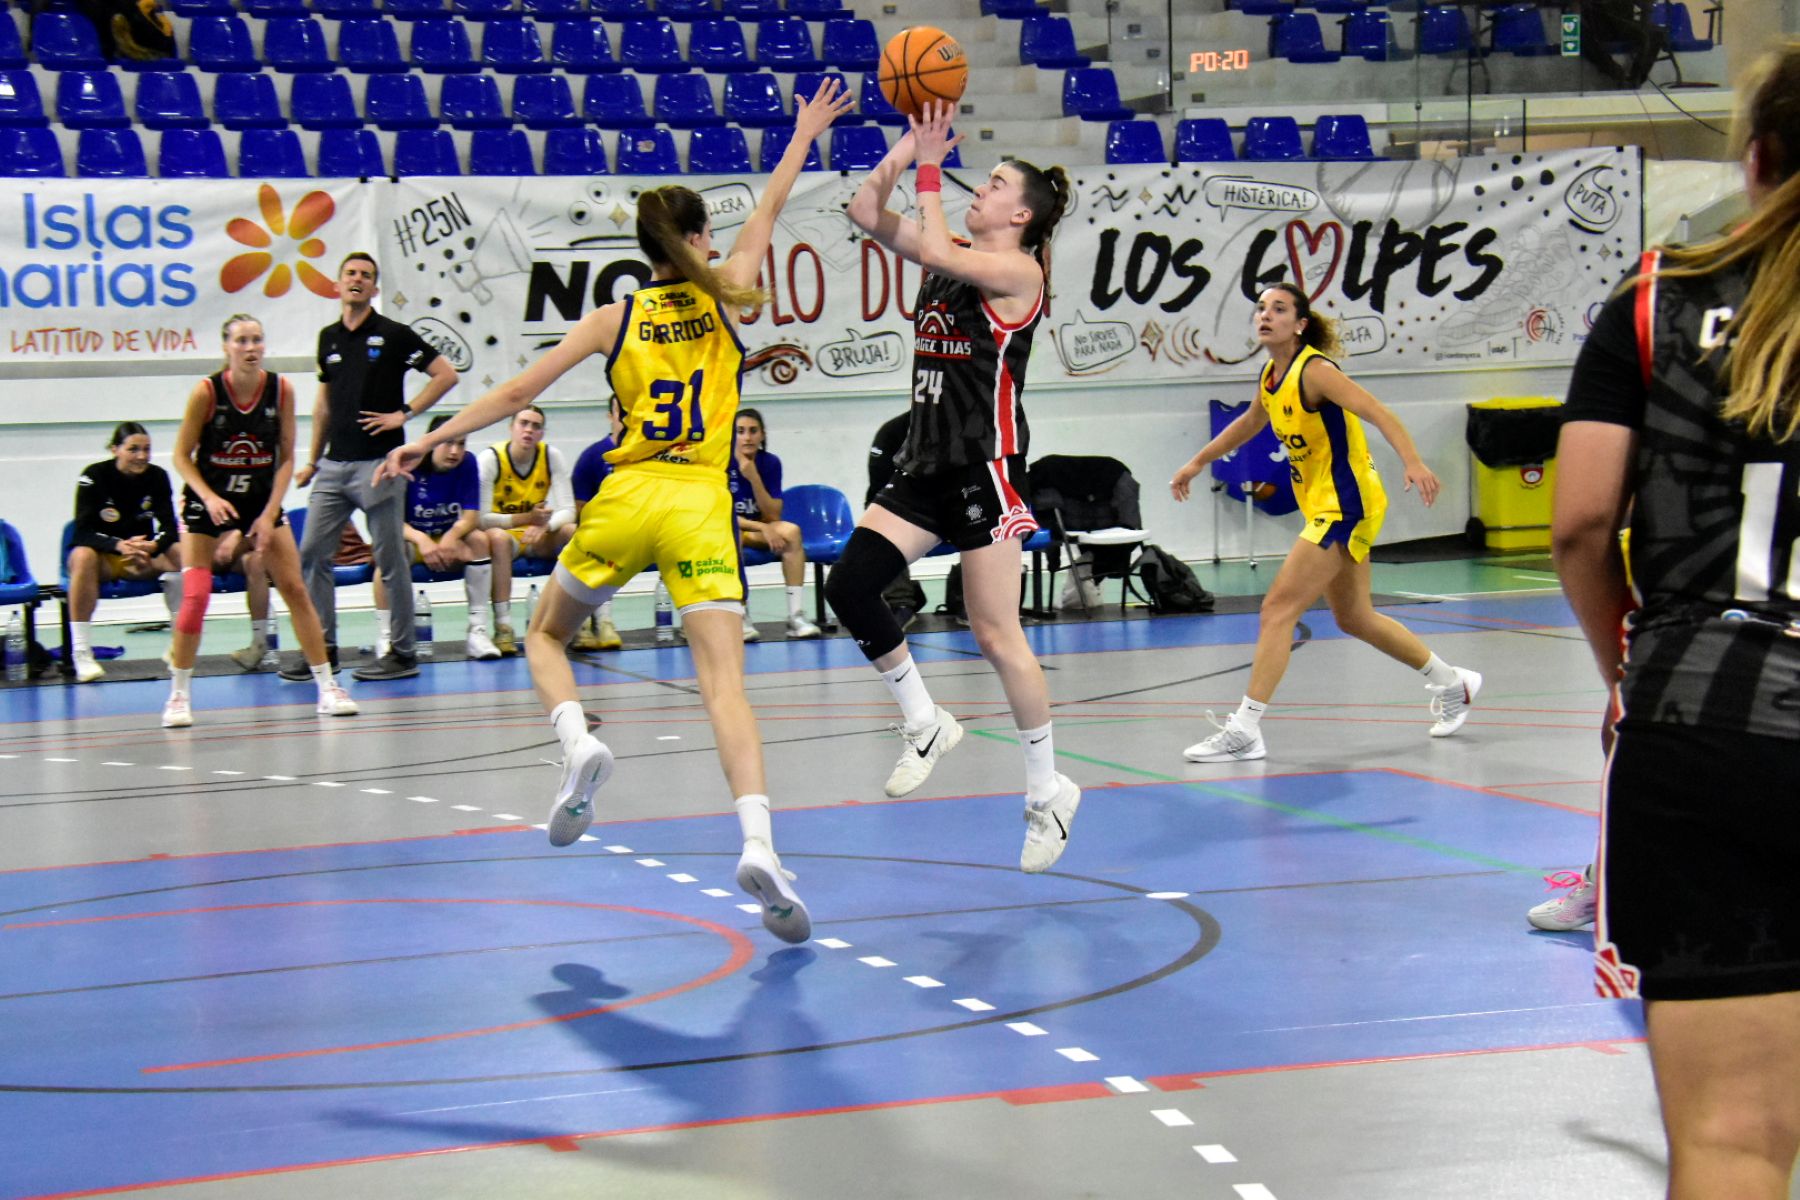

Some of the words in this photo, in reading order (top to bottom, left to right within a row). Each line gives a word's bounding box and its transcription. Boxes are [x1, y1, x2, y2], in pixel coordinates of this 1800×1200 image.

[1573, 184, 1606, 215] PUTA
[23, 192, 194, 250] Islas
[394, 192, 471, 257] #25N
[1090, 228, 1211, 313] LOS
[113, 330, 140, 352] DE
[146, 328, 197, 352] VIDA
[942, 340, 972, 356] TIAS
[1340, 326, 1372, 344] OLFA
[828, 341, 889, 370] BRUJA!
[915, 369, 944, 404] 24
[642, 369, 705, 441] 31
[226, 474, 252, 492] 15
